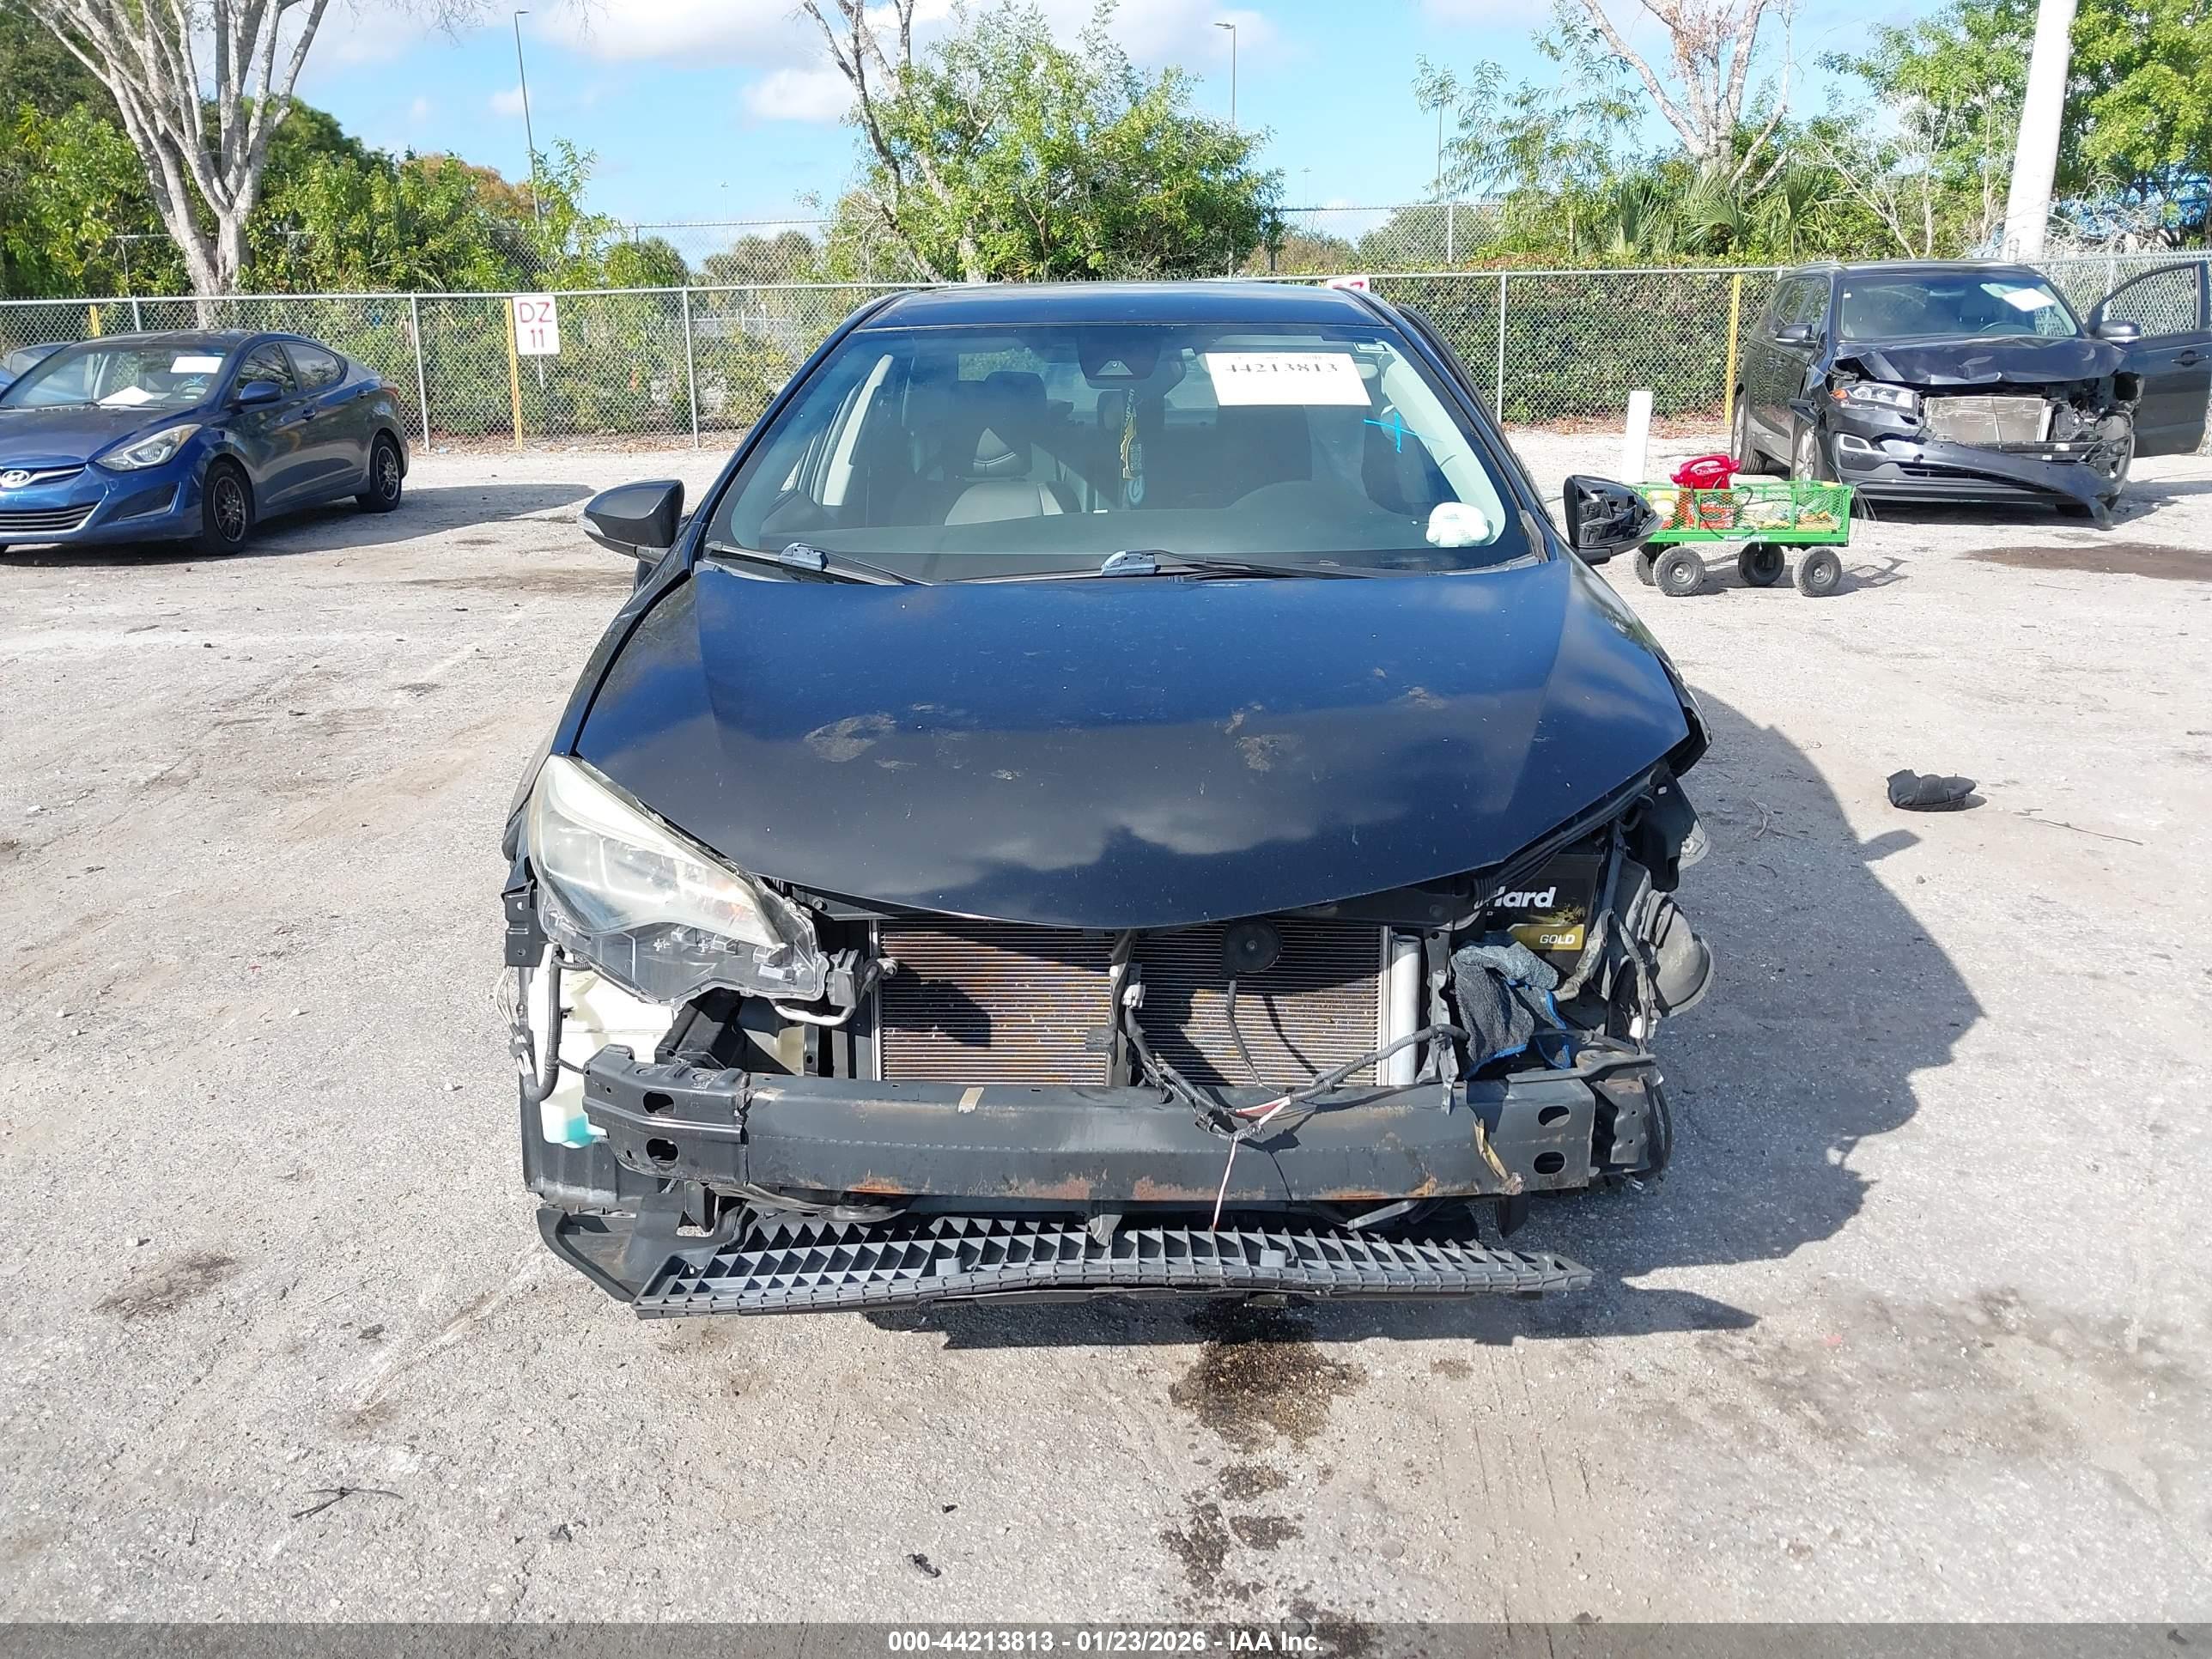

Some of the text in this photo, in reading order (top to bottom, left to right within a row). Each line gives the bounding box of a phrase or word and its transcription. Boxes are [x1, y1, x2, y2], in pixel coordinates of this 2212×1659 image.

[519, 301, 552, 323] DZ
[530, 328, 544, 348] 11
[1225, 363, 1339, 373] 44213813
[1540, 934, 1576, 945] GOLD
